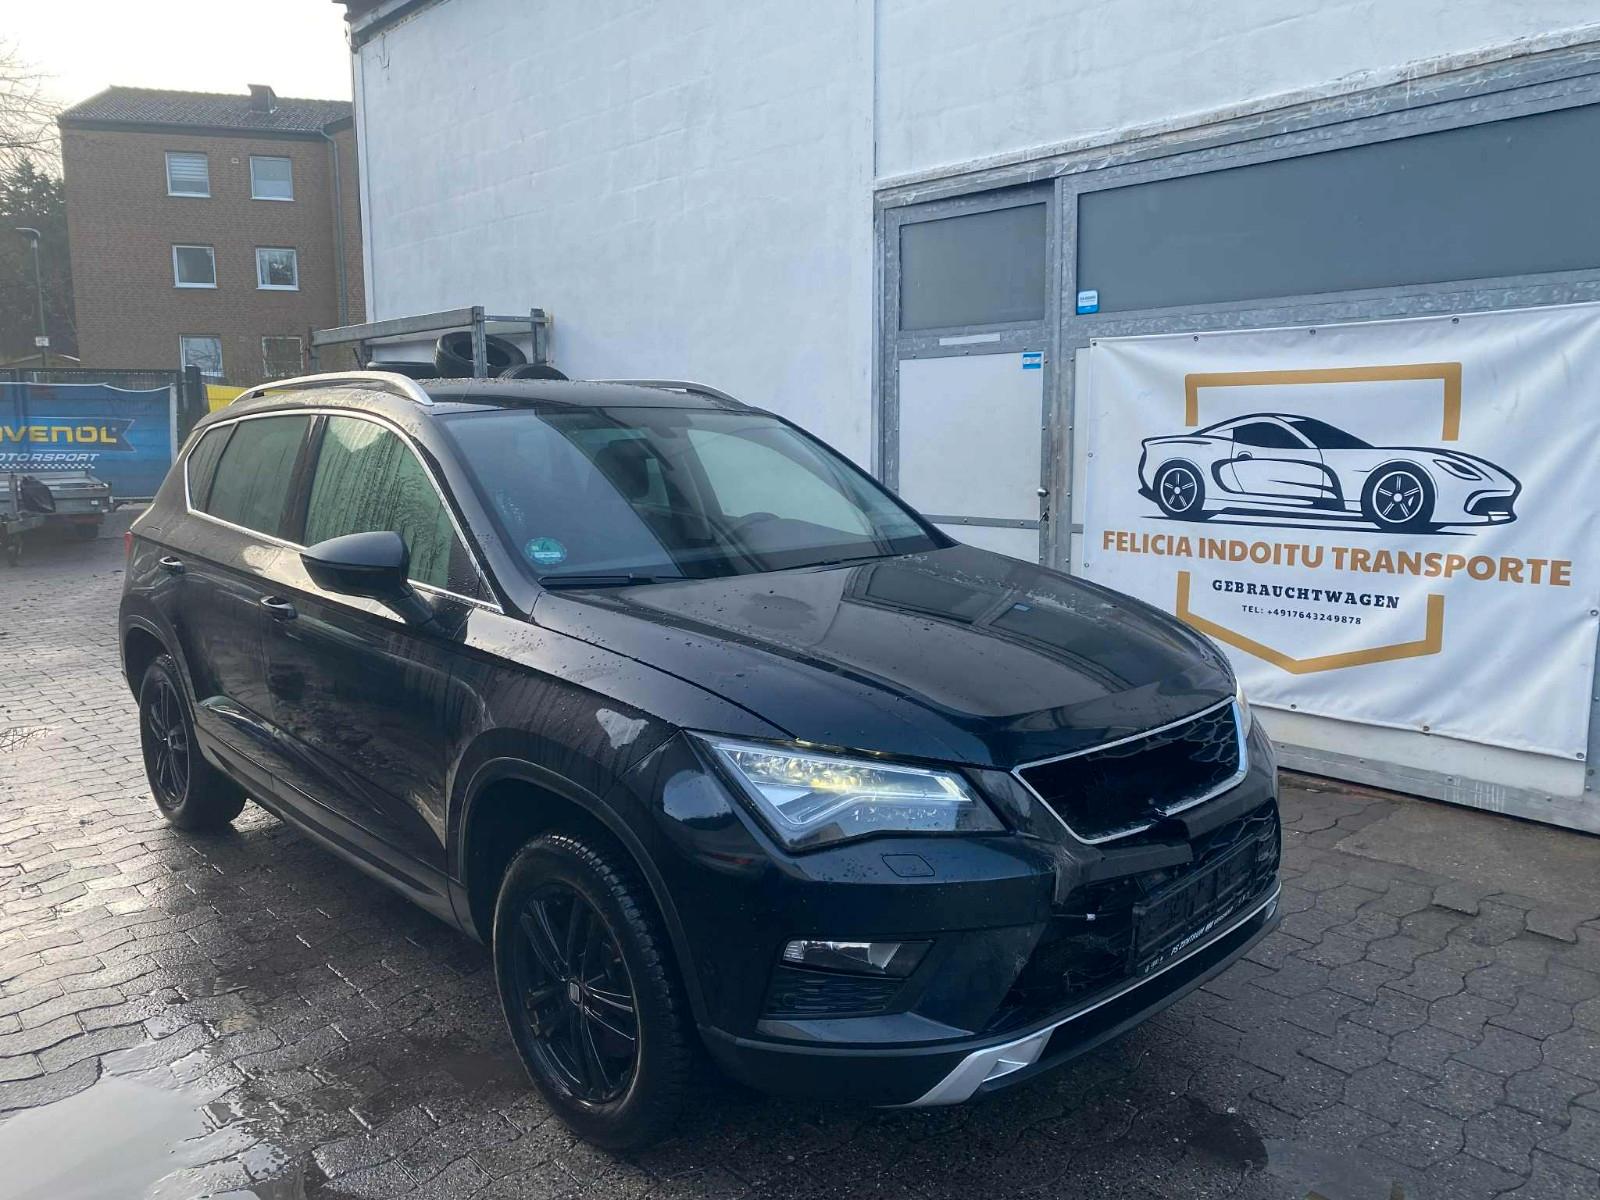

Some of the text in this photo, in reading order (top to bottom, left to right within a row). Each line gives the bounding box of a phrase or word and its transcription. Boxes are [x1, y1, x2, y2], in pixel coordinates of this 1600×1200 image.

[0, 426, 117, 443] VENOL
[1103, 530, 1573, 587] FELICIA INDOITU TRANSPORTE
[1212, 579, 1401, 609] GEBRAUCHTWAGEN
[1241, 604, 1362, 625] TEL: +4917643249878
